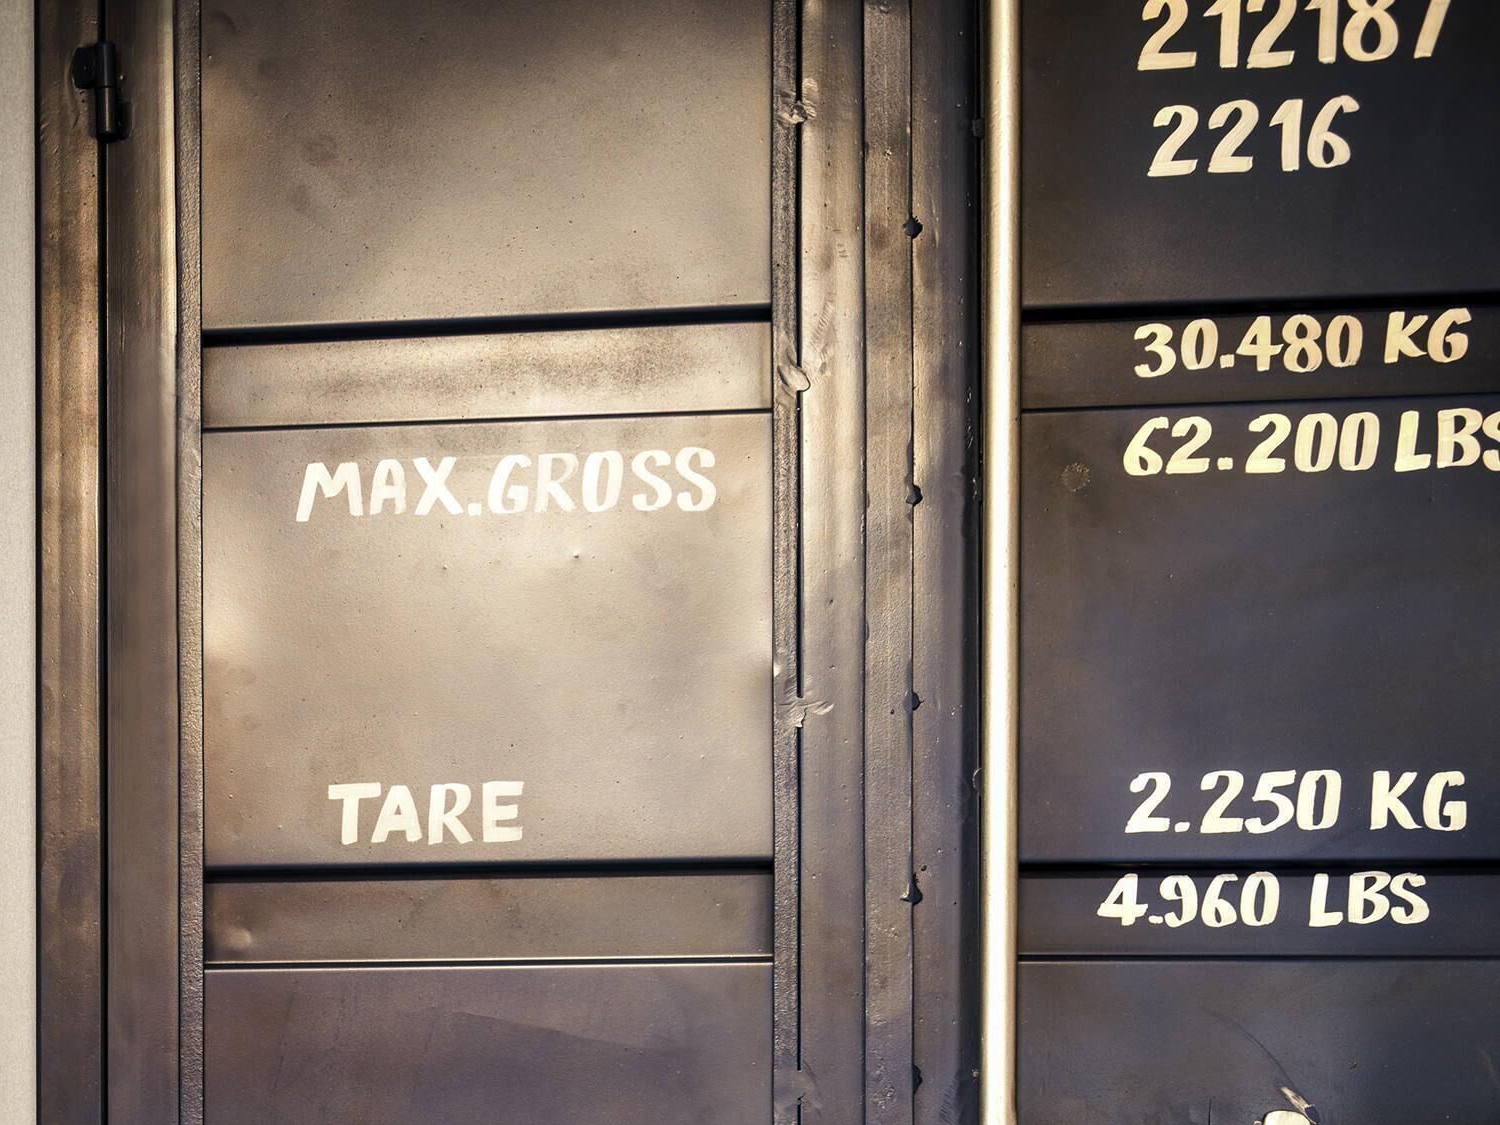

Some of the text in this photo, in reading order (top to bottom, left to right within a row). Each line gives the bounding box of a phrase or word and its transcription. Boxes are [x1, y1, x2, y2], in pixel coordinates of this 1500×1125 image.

[1146, 94, 1360, 178] 2216
[1133, 307, 1472, 378] 30.480 KG
[1122, 411, 1380, 476] 62.200
[296, 446, 718, 522] MAX.GROSS
[327, 780, 525, 846] TARE
[1124, 769, 1467, 834] 2.250 KG
[1096, 870, 1430, 928] 4.960 LBS
